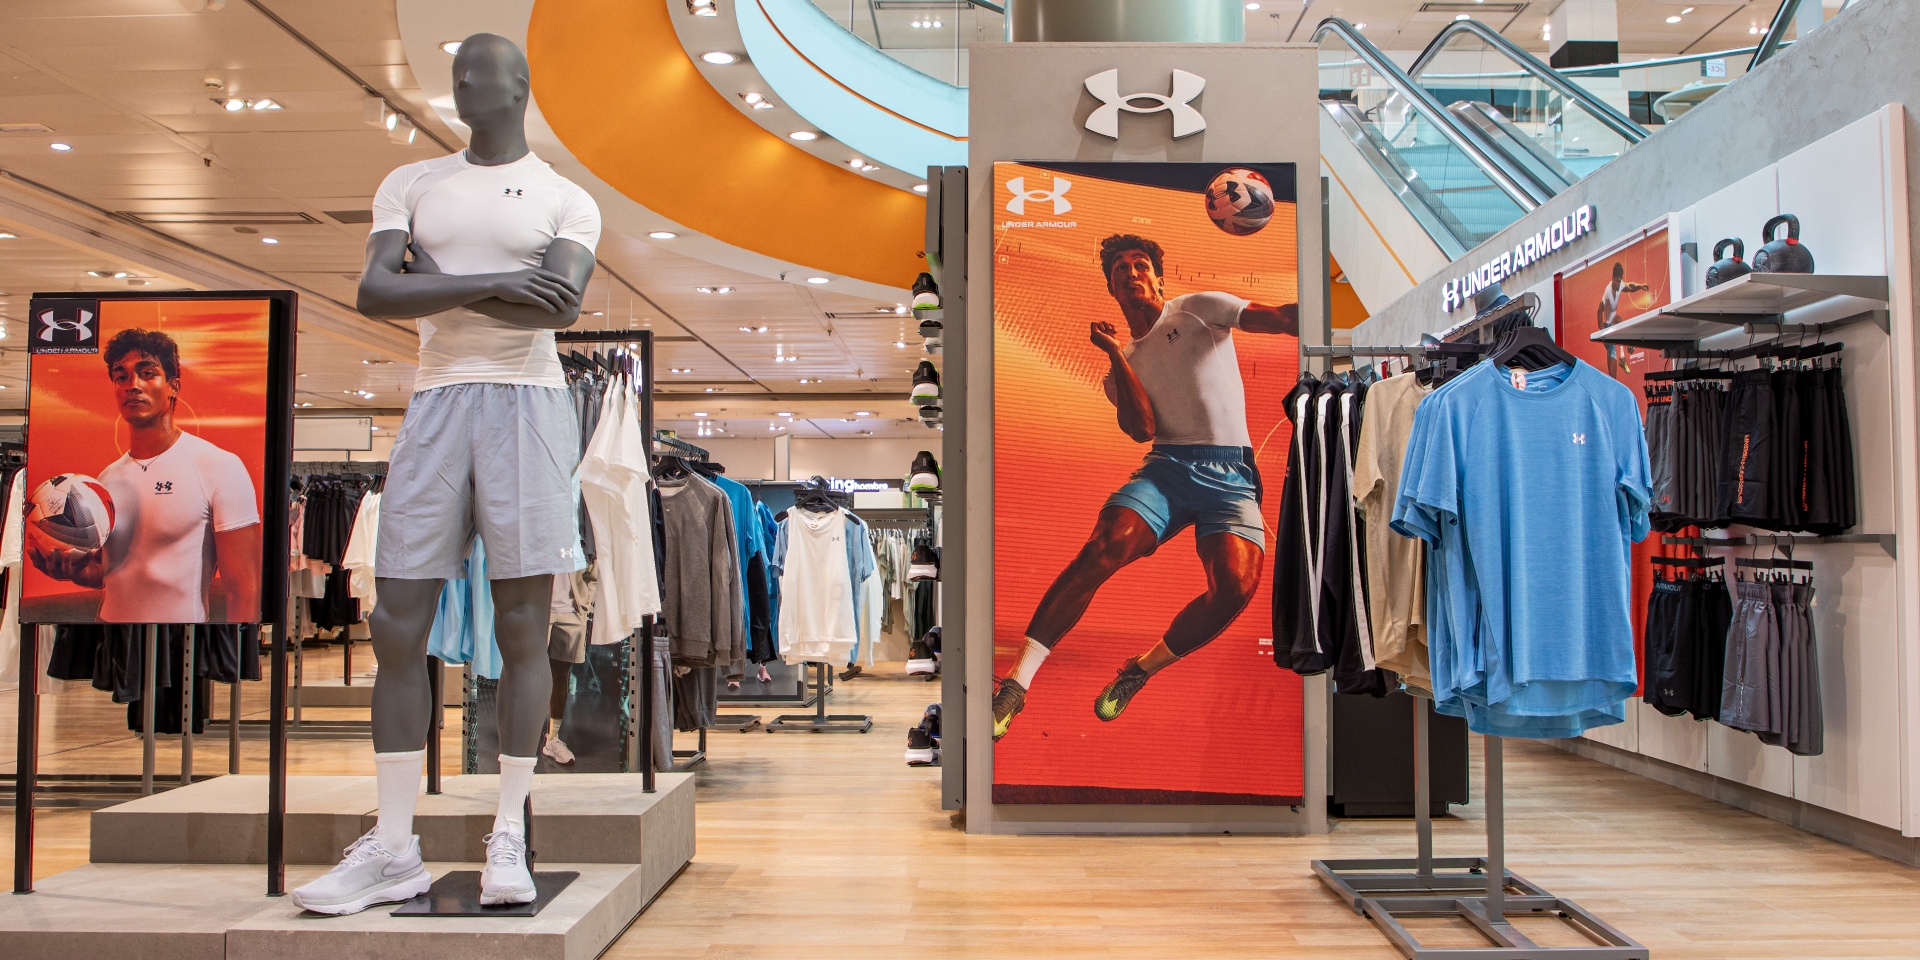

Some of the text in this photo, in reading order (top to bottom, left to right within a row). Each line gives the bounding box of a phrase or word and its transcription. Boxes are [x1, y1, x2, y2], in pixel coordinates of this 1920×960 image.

[1462, 204, 1592, 299] UNDER ARMOUR
[854, 481, 889, 490] hombre
